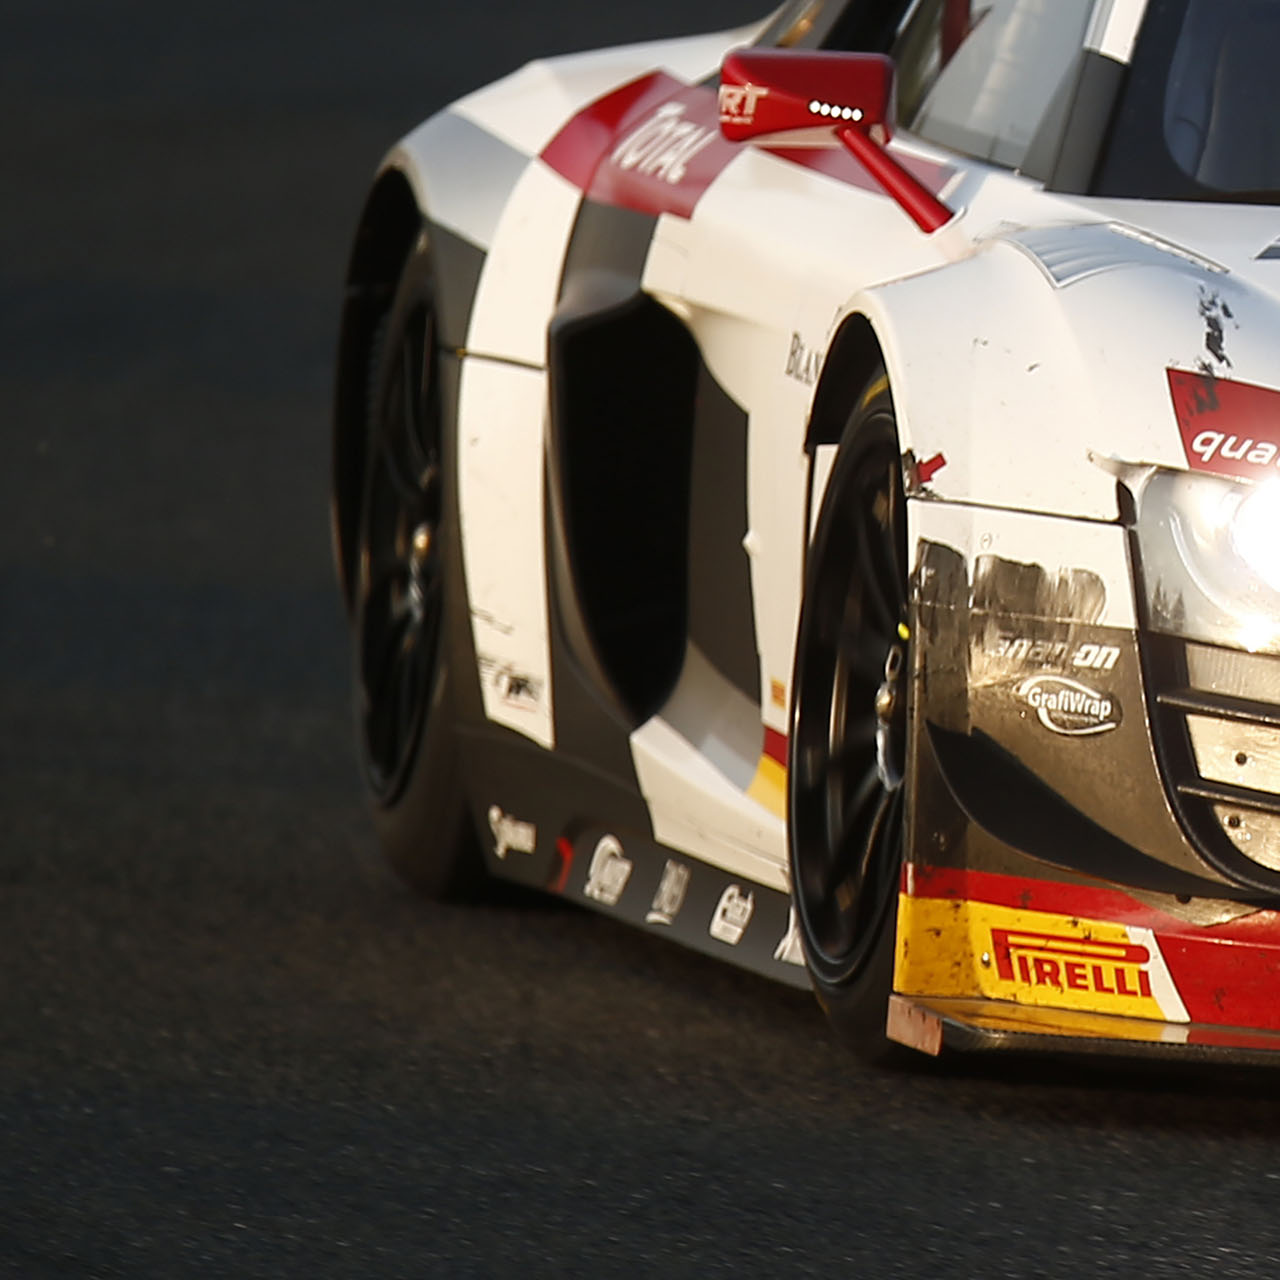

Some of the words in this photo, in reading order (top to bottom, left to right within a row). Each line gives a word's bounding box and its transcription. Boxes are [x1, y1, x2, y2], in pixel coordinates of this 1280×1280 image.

[610, 101, 720, 185] TOTAL
[1028, 686, 1112, 721] GrafiWrap
[990, 927, 1153, 998] PIRELLI
